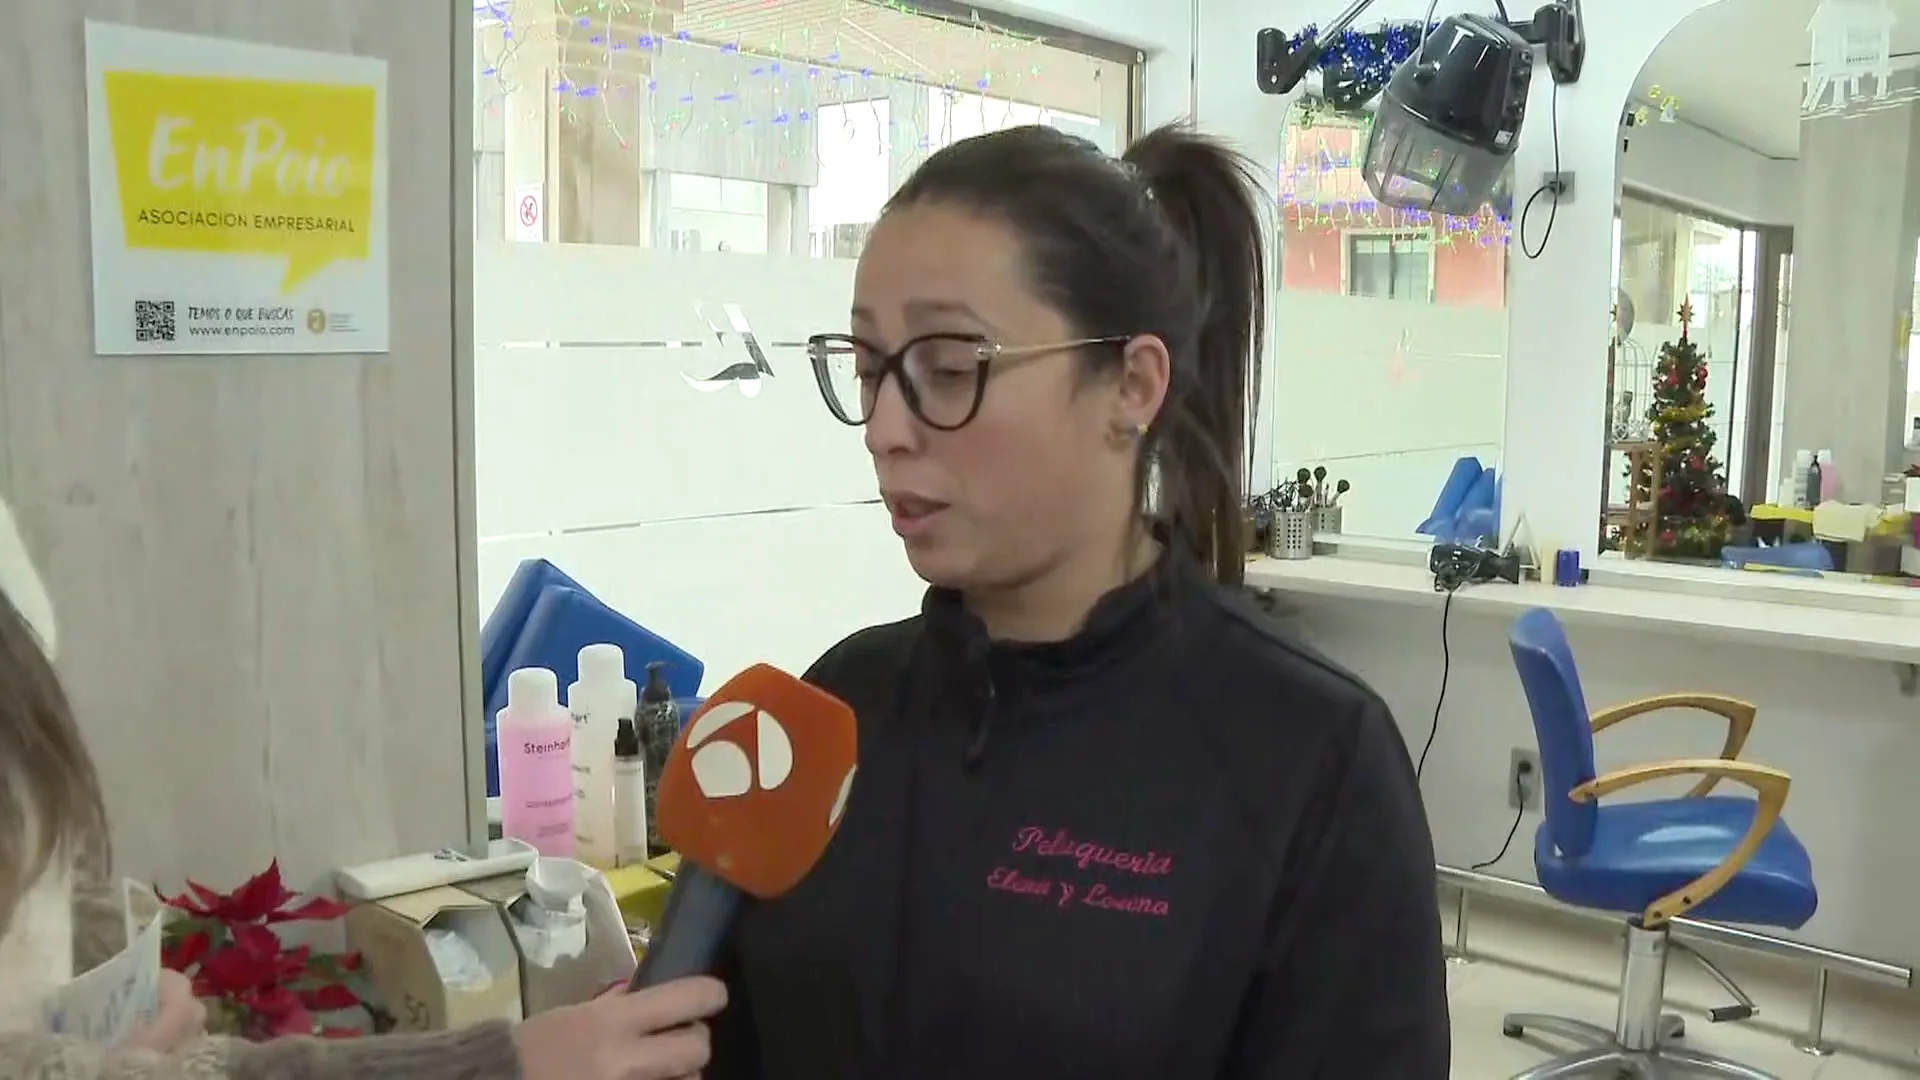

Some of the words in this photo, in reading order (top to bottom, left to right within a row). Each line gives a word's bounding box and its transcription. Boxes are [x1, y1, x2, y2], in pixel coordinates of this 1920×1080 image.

[148, 113, 350, 198] EnPoio
[138, 209, 248, 228] ASOCIACION
[254, 214, 355, 232] EMPRESARIAL
[188, 306, 221, 321] TEMOS
[235, 307, 254, 321] QUE
[258, 307, 294, 320] BUSCAS
[188, 326, 295, 336] www.enpoio.com
